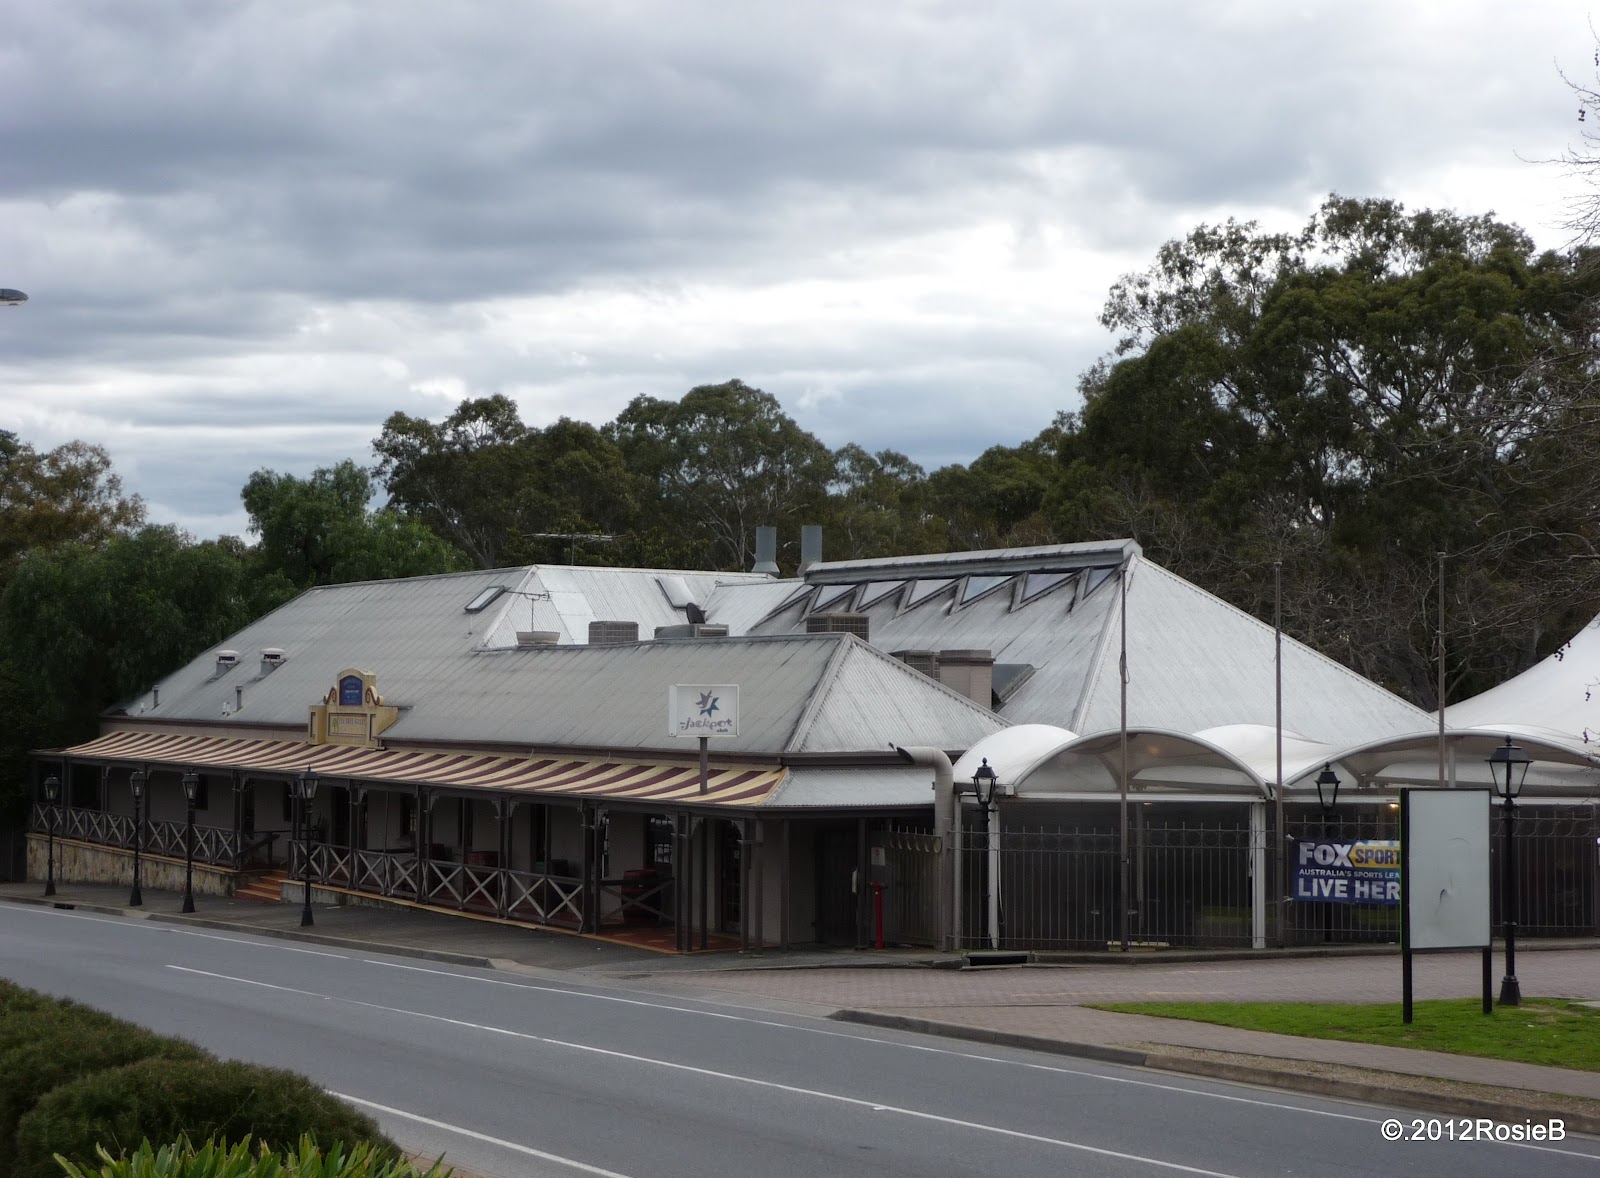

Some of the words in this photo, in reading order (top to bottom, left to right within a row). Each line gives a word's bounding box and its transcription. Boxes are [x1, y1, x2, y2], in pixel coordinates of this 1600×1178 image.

[1300, 842, 1353, 868] FOX
[1354, 848, 1400, 865] SPORT
[1299, 868, 1353, 877] AUSTRALIA'S
[1353, 870, 1384, 879] SPORTS
[1384, 871, 1400, 879] LEA
[1298, 878, 1348, 898] LIVE
[1354, 880, 1400, 900] HER
